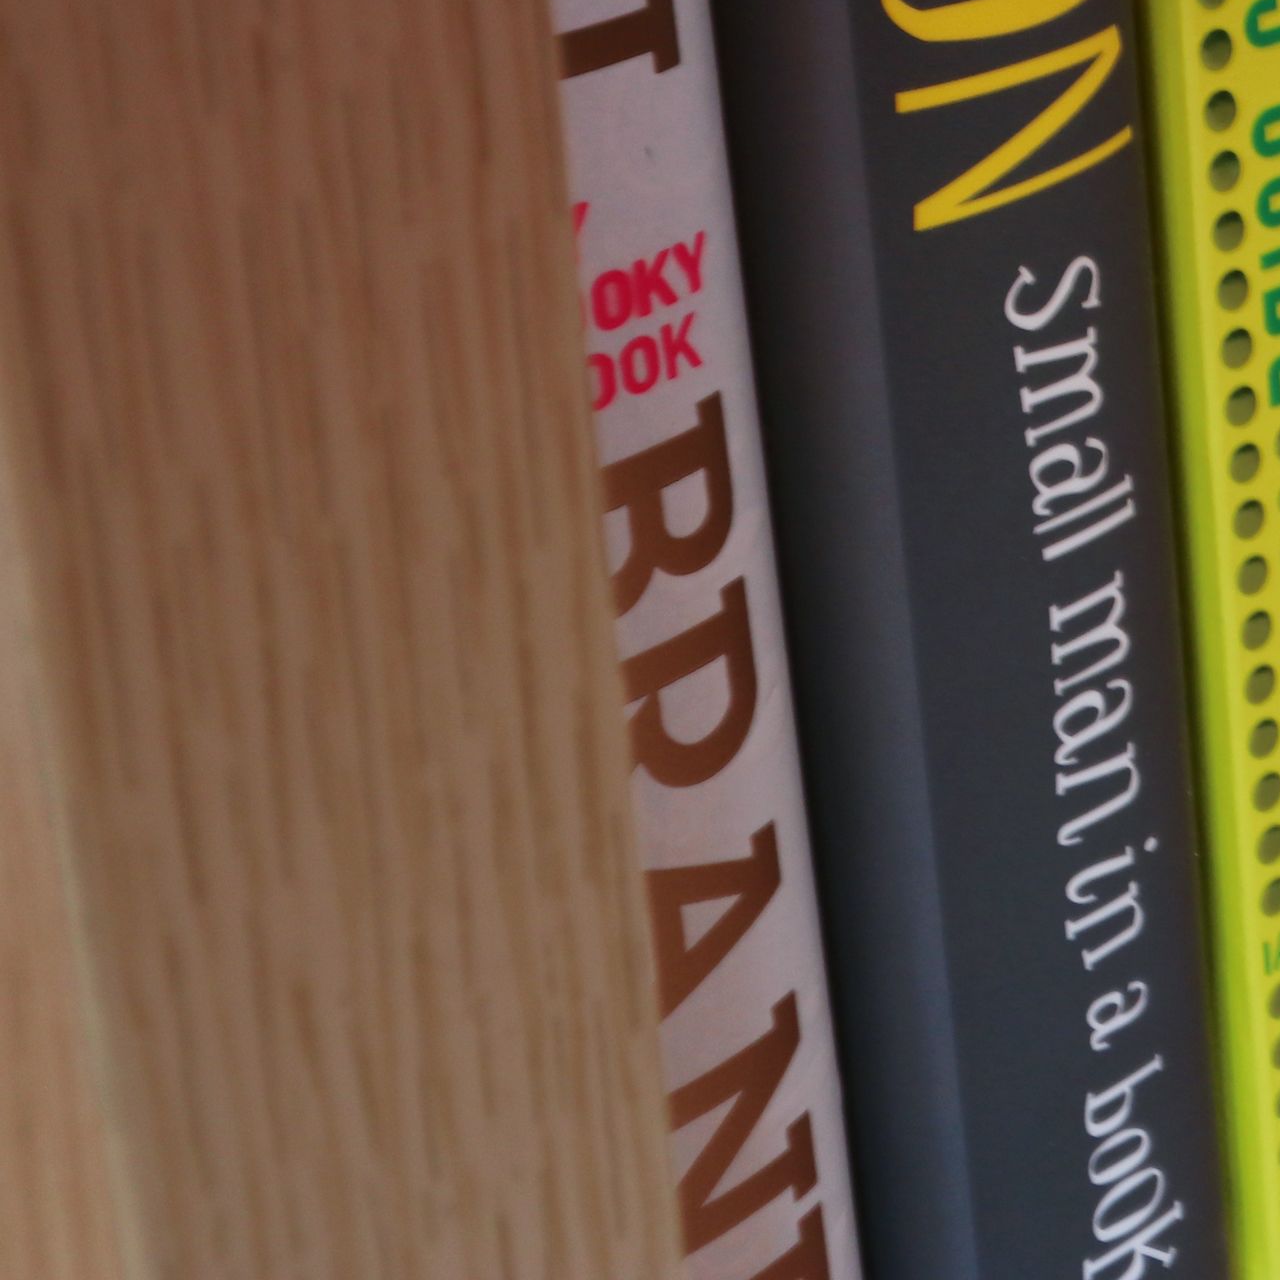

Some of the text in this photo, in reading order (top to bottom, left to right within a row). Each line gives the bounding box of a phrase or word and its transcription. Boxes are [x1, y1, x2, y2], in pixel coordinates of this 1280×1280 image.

[582, 230, 706, 332] OKY
[586, 312, 703, 412] OOK
[1047, 569, 1142, 848] man
[1063, 836, 1159, 972] in
[1084, 979, 1150, 1053] a
[1081, 1052, 1186, 1280] book
